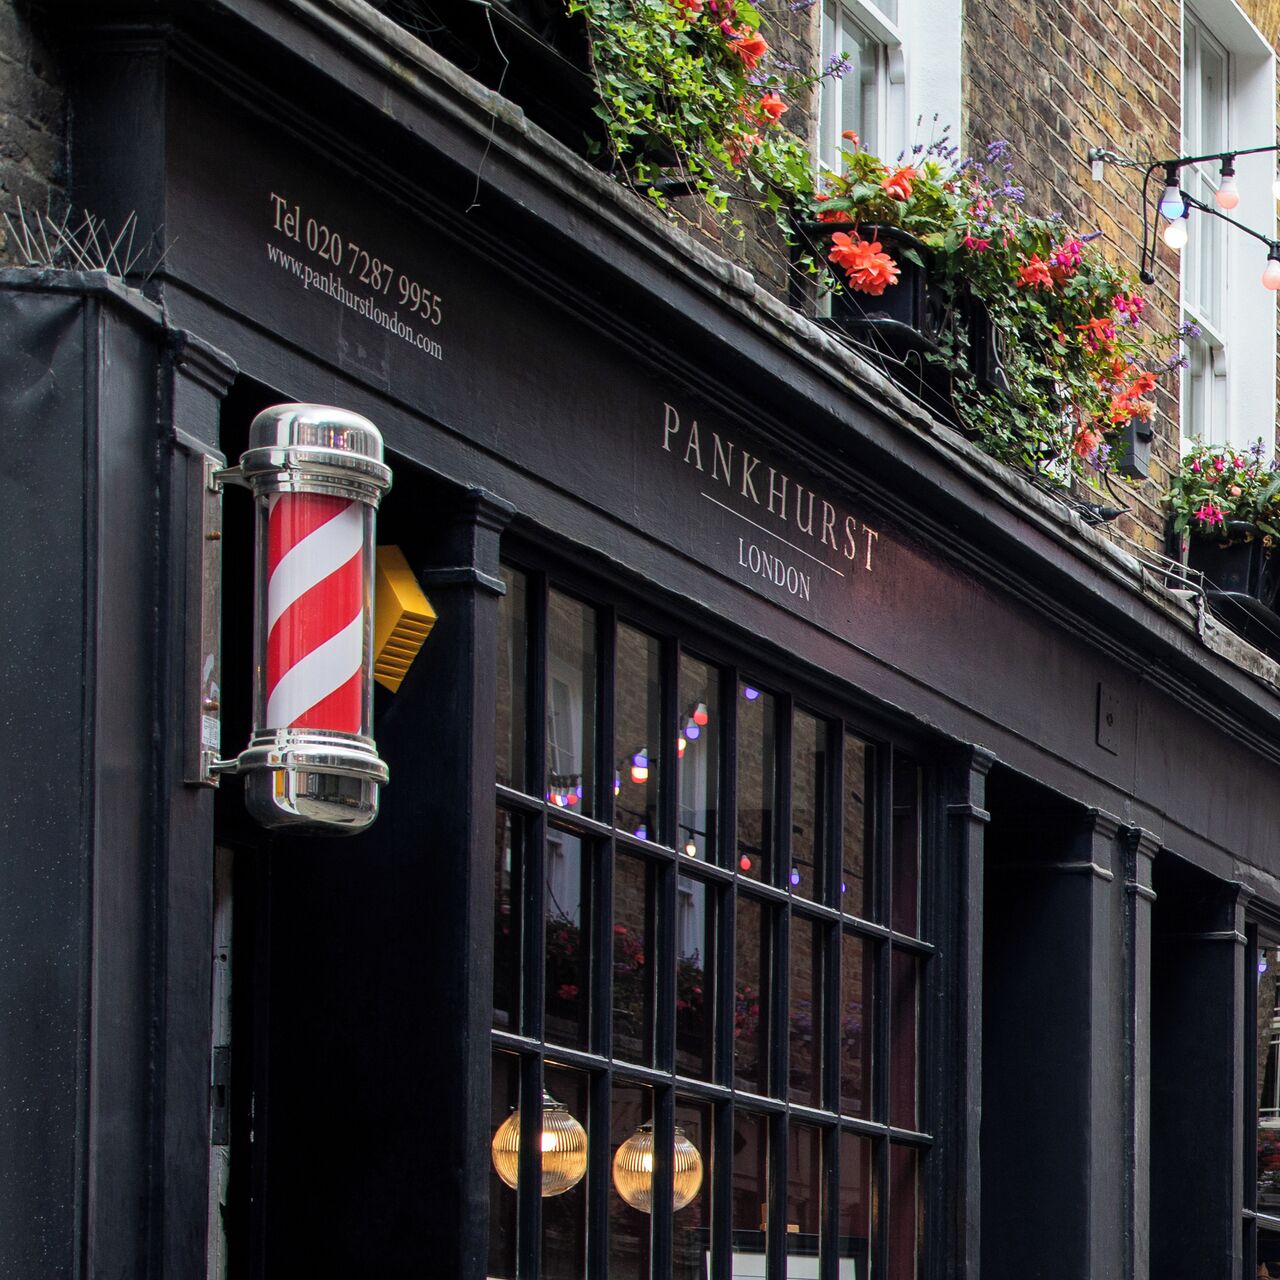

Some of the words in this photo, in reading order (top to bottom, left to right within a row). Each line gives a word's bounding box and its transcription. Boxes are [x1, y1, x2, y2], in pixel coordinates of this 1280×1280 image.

[267, 243, 443, 361] www.pankhurstlondon.com
[270, 192, 301, 243] Tel
[306, 218, 342, 266] 020
[348, 242, 394, 295] 7287
[398, 275, 442, 326] 9955
[661, 402, 879, 572] PANKHURST
[738, 537, 811, 602] LONDON
